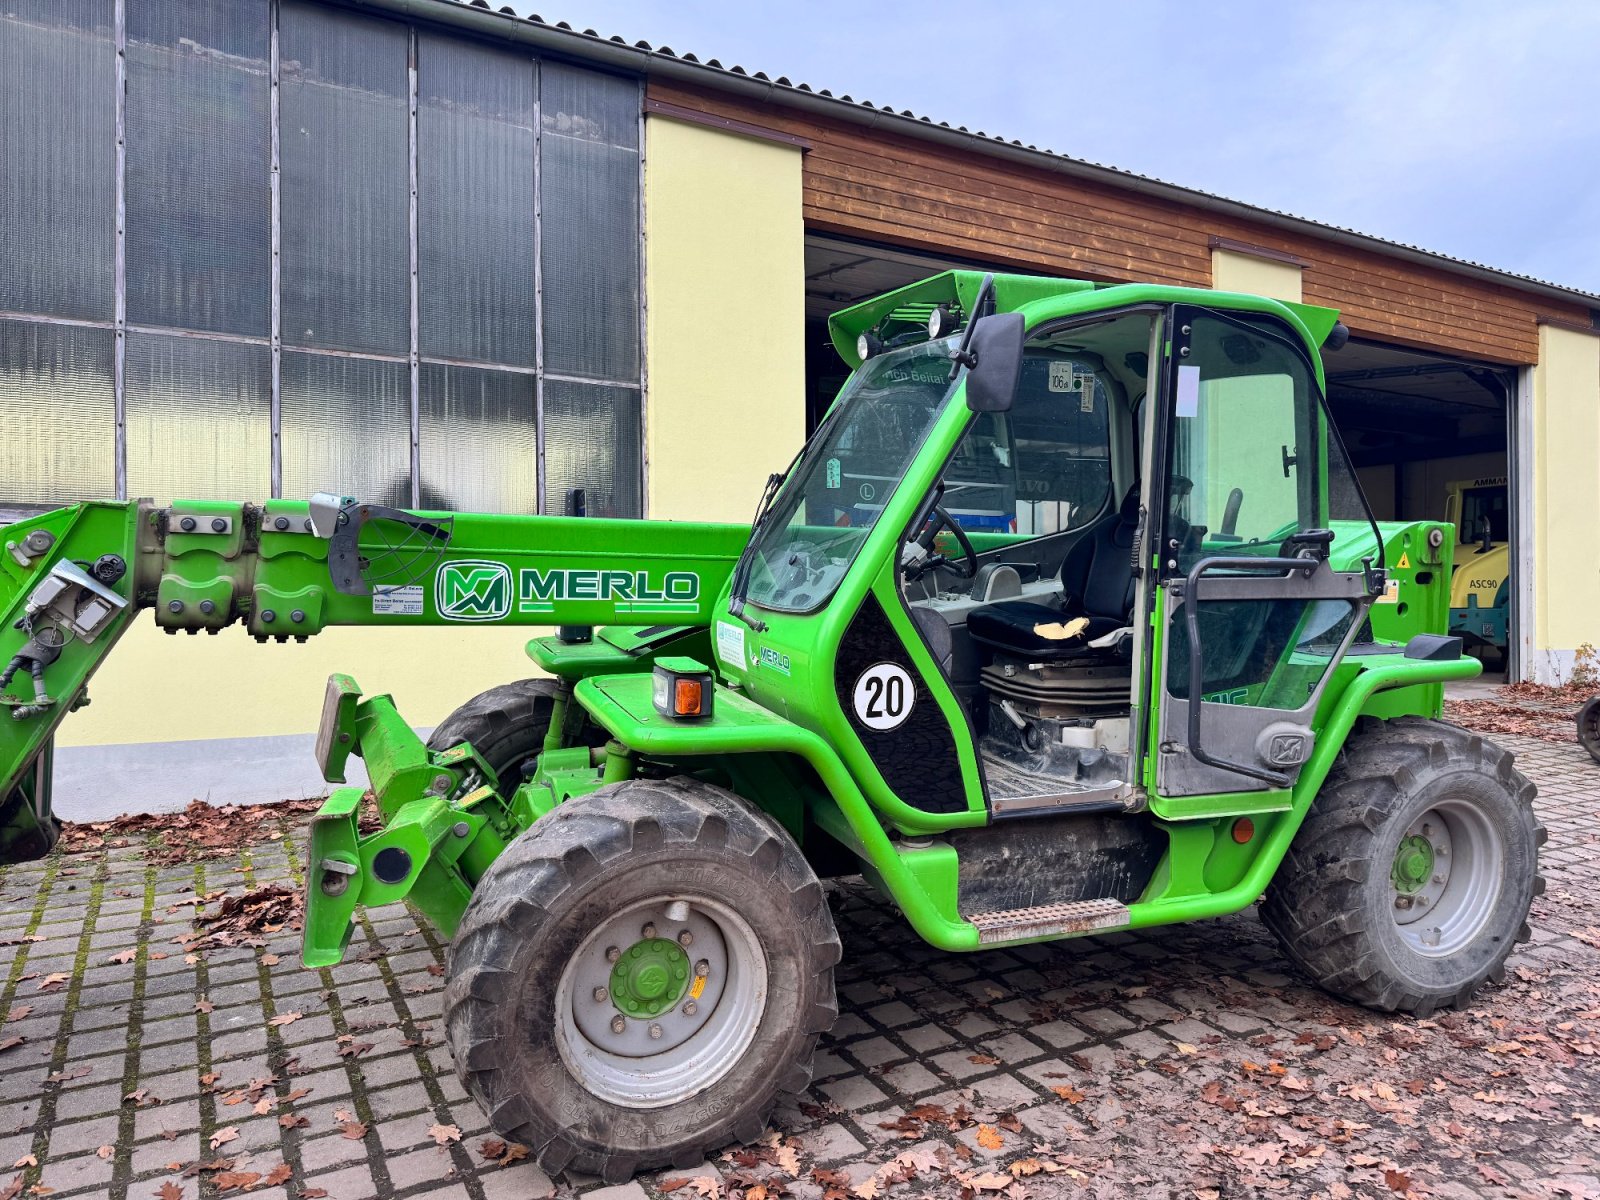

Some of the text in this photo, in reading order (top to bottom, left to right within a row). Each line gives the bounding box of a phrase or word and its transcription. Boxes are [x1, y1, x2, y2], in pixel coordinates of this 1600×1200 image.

[519, 568, 700, 602] MERLO
[1469, 579, 1498, 589] ASC90
[760, 645, 791, 671] MERLO
[864, 675, 904, 718] 20
[672, 866, 747, 897] MITAS
